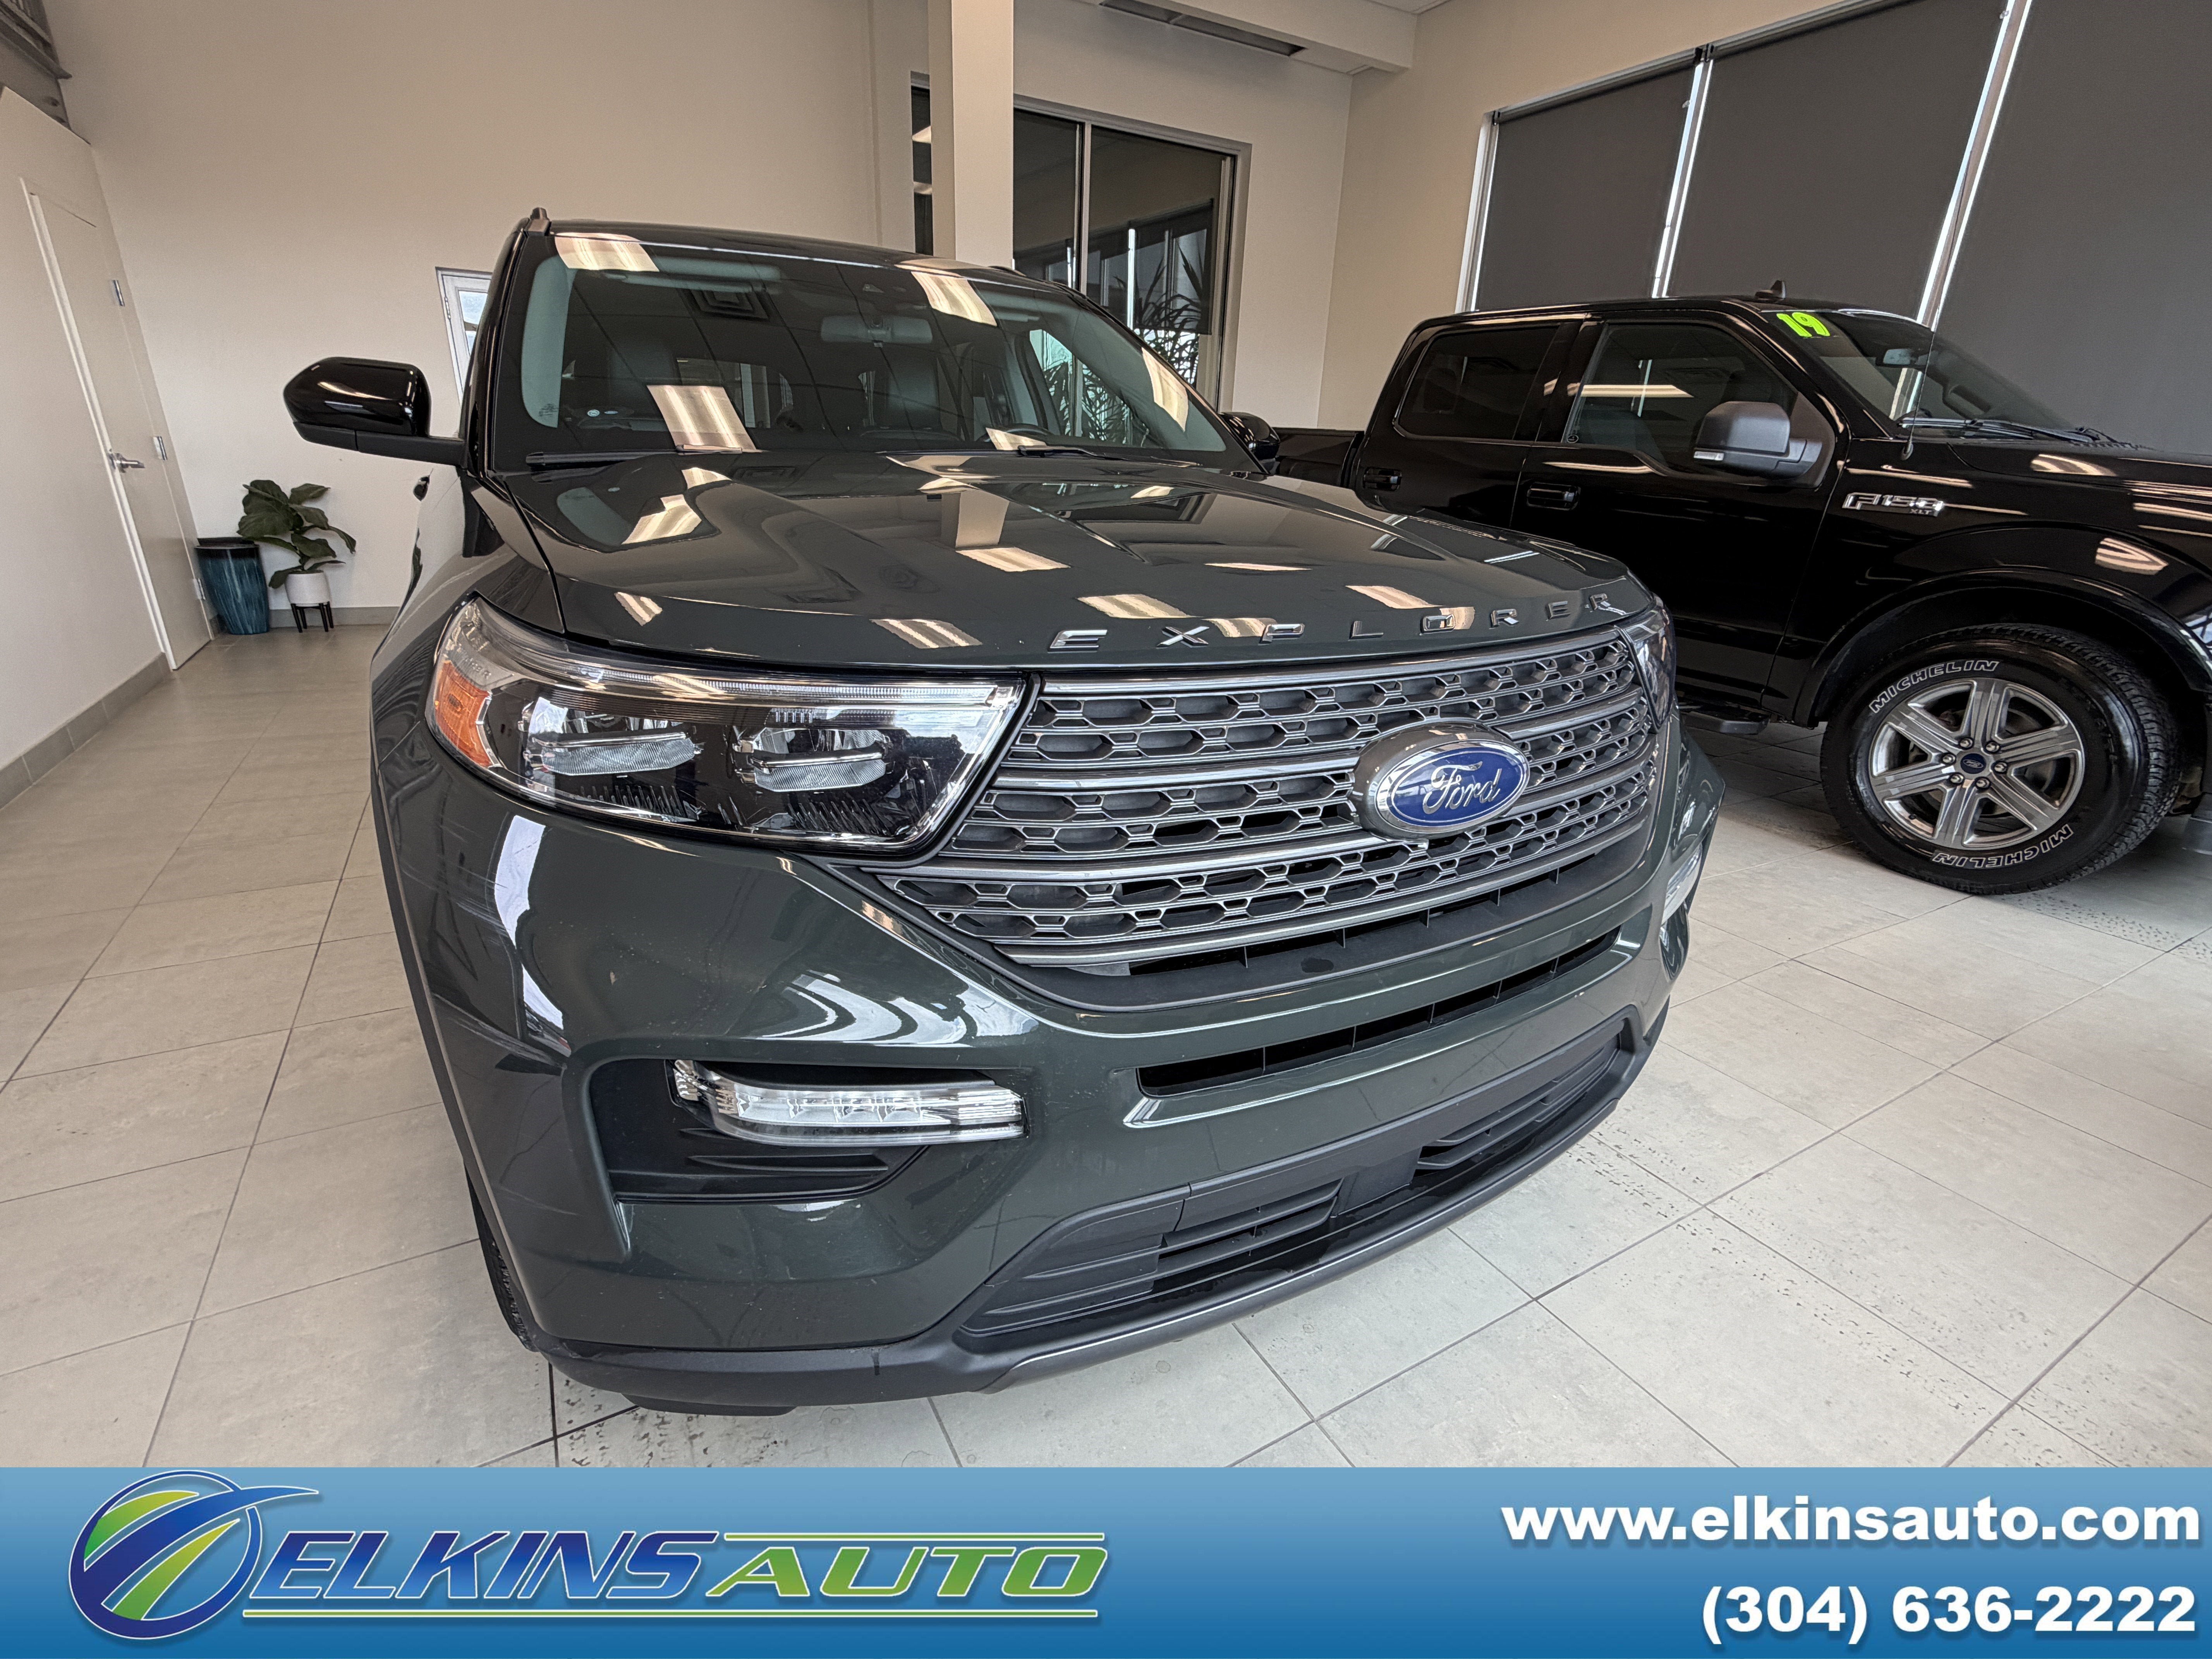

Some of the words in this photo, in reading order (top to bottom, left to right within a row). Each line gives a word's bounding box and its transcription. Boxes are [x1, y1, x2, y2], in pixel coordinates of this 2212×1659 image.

[1776, 312, 1830, 337] 19
[1048, 593, 1610, 652] EXPLORER
[1868, 660, 1999, 713] MICHELIN
[1422, 761, 1503, 814] Ford
[1932, 824, 2074, 868] MICHELIN
